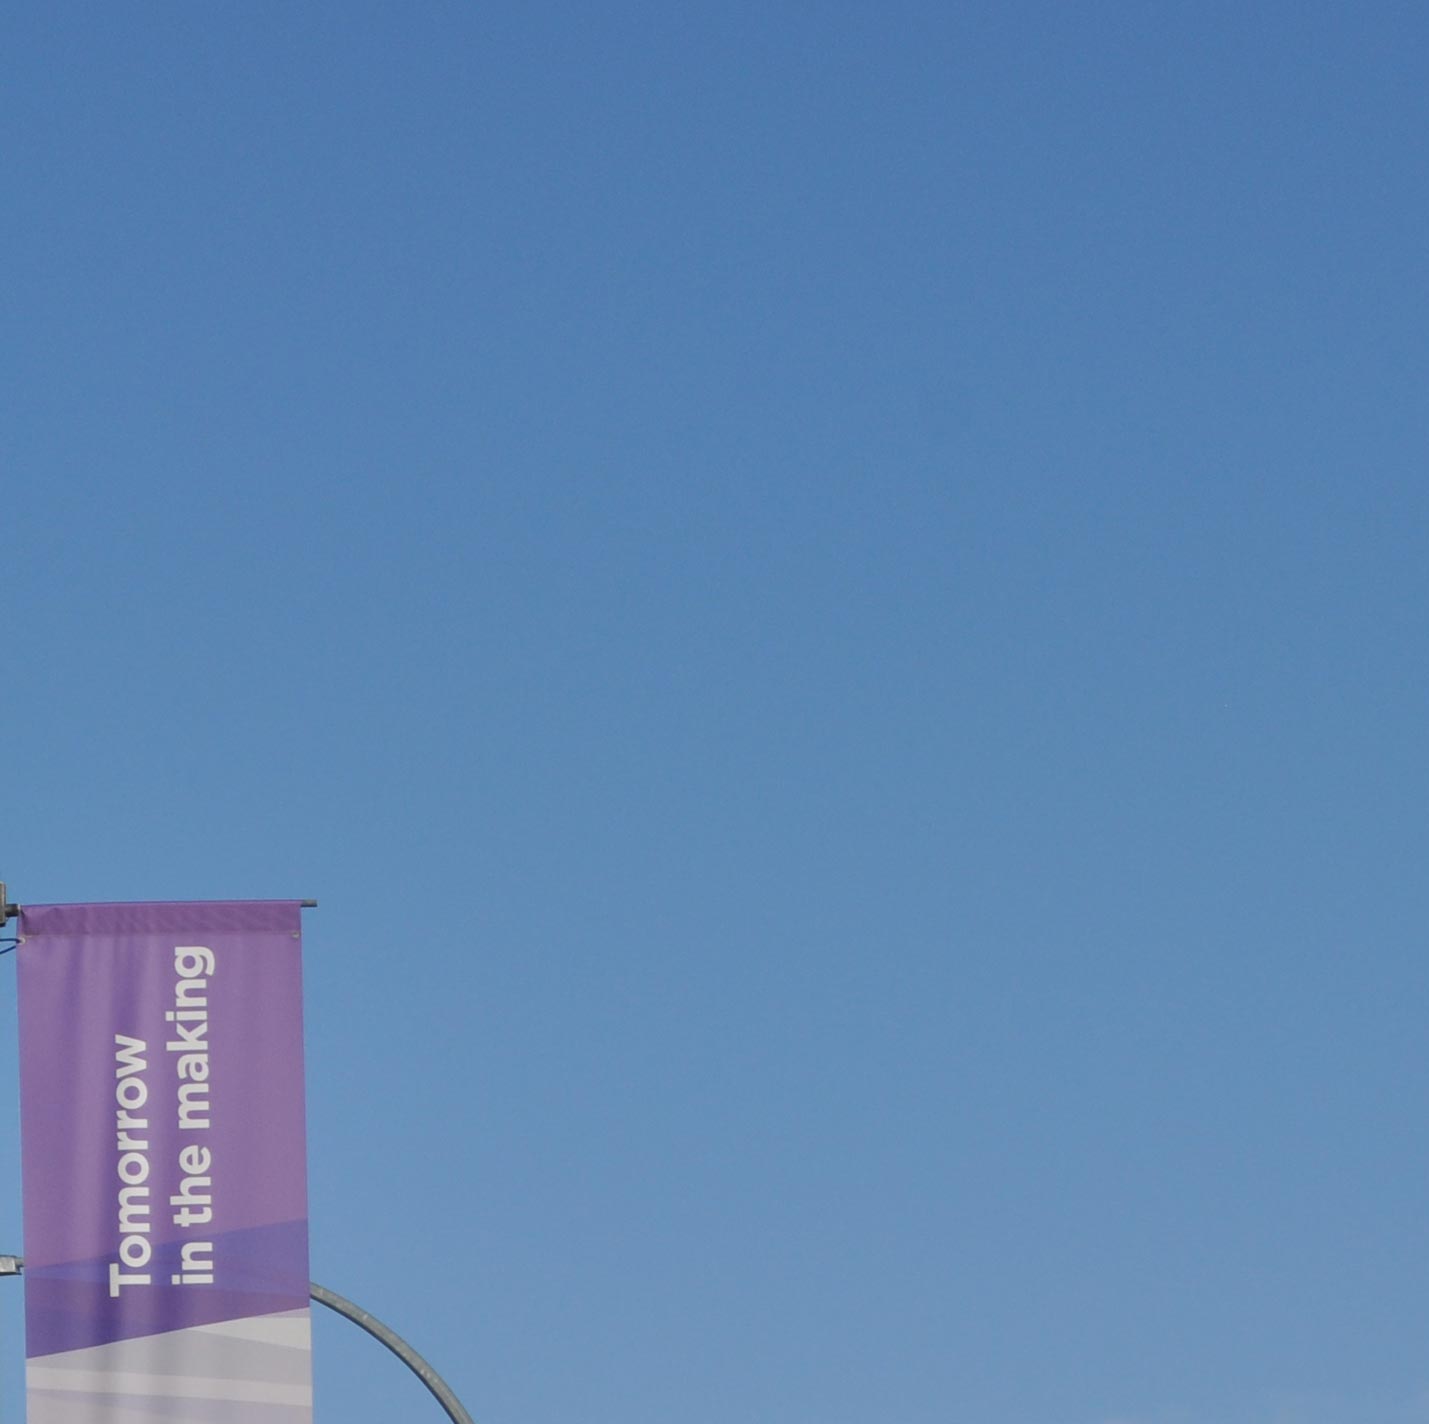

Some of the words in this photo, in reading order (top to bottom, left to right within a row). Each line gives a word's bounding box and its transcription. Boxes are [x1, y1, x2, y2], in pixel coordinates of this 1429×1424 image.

[165, 945, 216, 1129] making
[109, 1034, 152, 1298] Tomorrow
[169, 1144, 213, 1228] the
[171, 1241, 214, 1286] in
